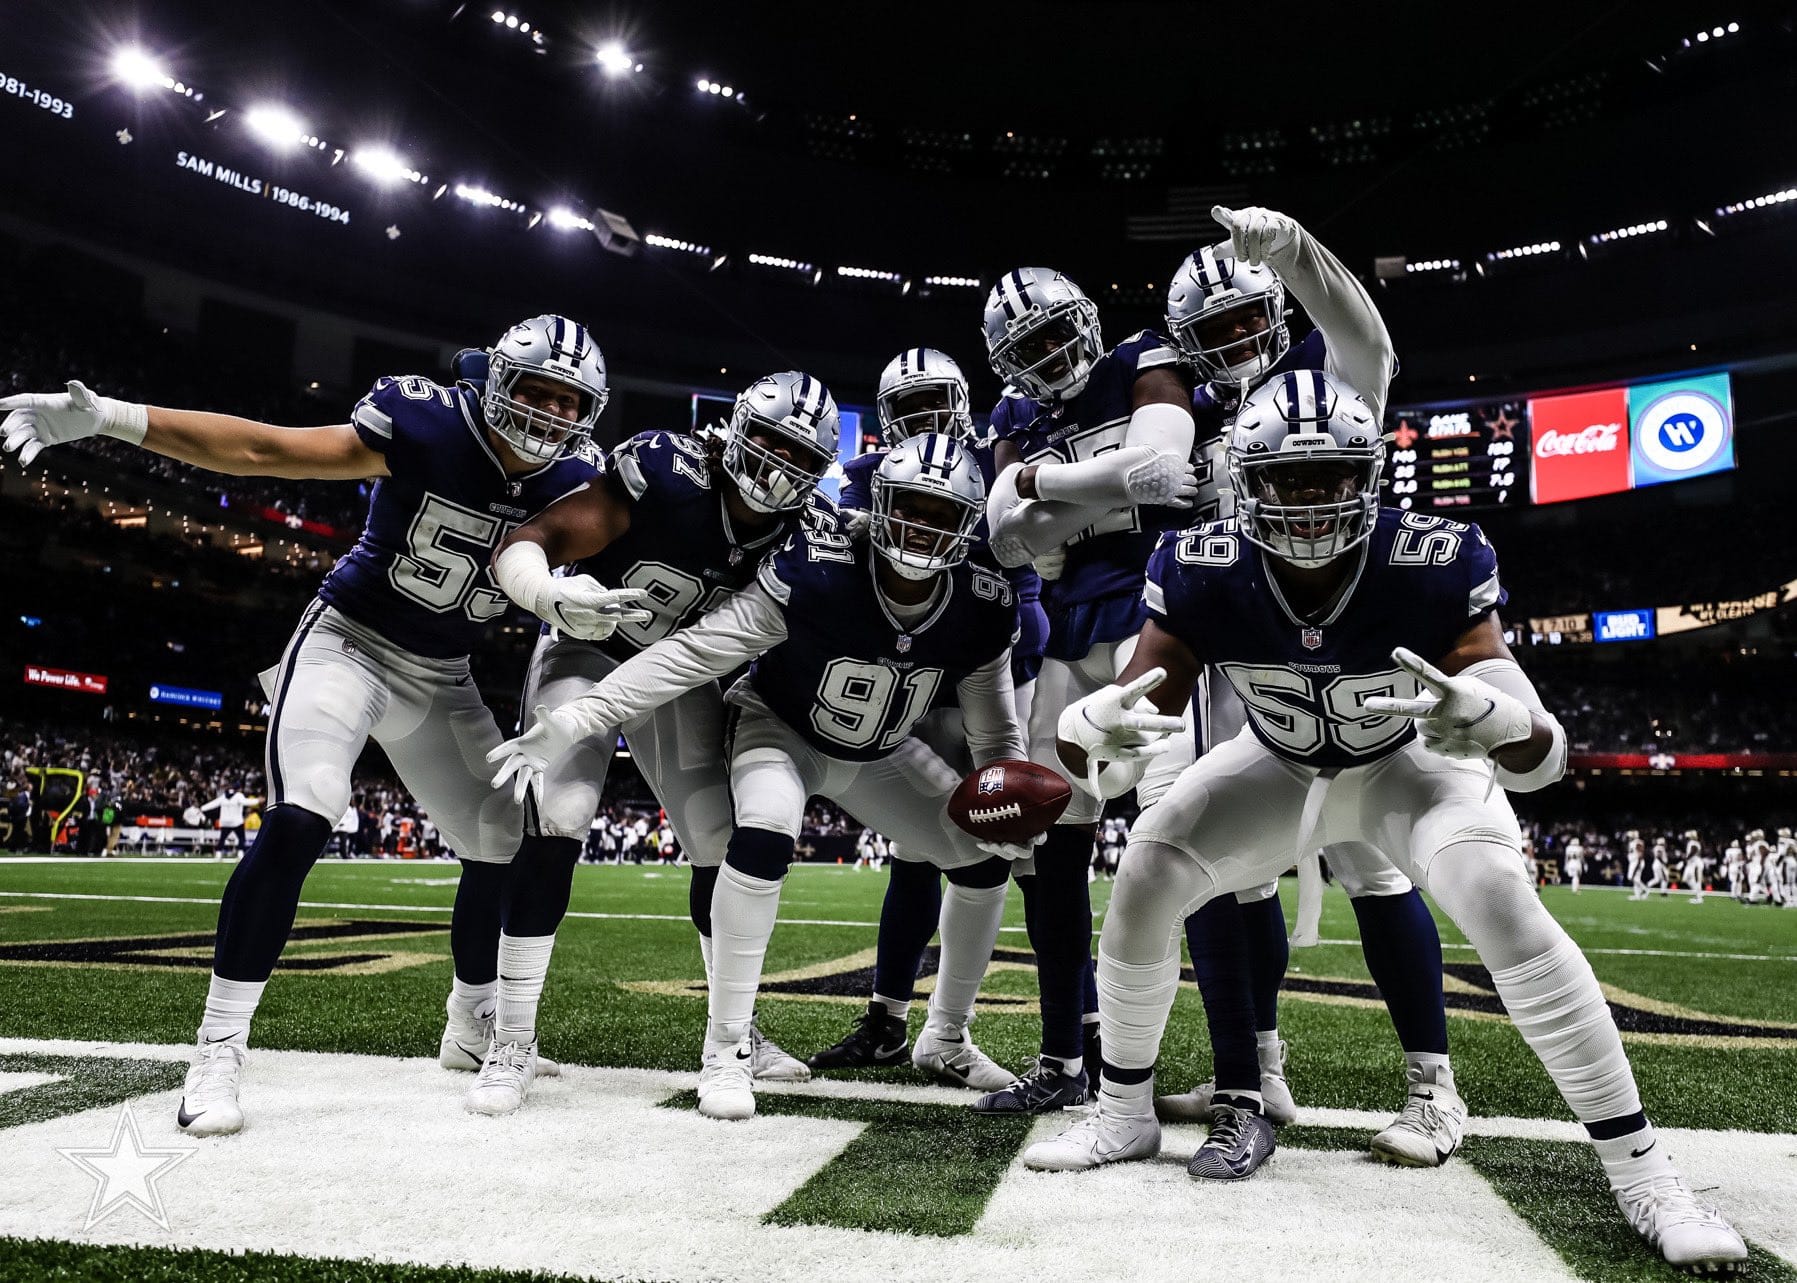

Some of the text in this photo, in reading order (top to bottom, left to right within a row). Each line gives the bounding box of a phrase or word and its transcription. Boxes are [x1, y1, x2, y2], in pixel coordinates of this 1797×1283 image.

[176, 151, 350, 225] SAM MILLS 1986-1994
[1293, 439, 1326, 447] COWBOYS
[1536, 423, 1622, 458] Coca-Cola
[1304, 636, 1320, 646] NFL
[28, 668, 40, 682] We
[41, 669, 64, 685] Power
[809, 656, 945, 751] 91
[1215, 660, 1424, 757] 59
